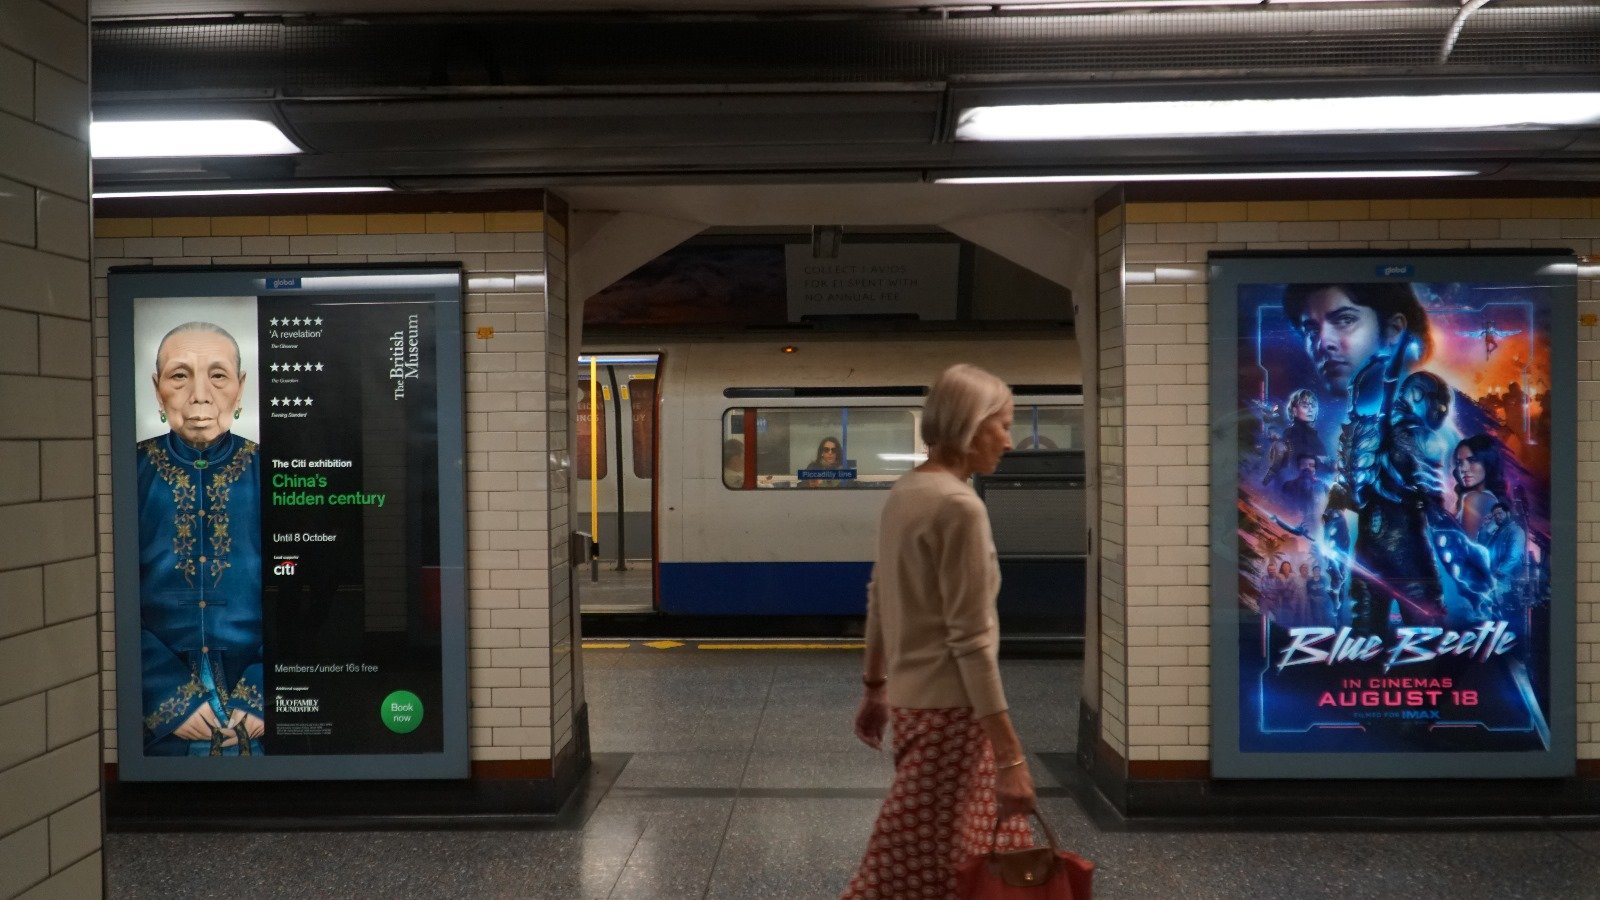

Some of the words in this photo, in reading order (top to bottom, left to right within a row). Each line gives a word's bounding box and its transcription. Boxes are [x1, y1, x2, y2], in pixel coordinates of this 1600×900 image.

[273, 278, 295, 288] global
[888, 279, 918, 288] WITH
[404, 314, 419, 380] Museum
[389, 330, 404, 380] British
[394, 380, 405, 401] The
[272, 459, 289, 468] The
[291, 459, 306, 468] Citi
[308, 459, 352, 468] exhibition
[802, 470, 836, 479] Piccadilly
[272, 491, 325, 506] hidden
[328, 491, 386, 508] century
[273, 533, 293, 543] Until
[294, 533, 301, 542] 8
[302, 533, 337, 542] October
[273, 563, 295, 576] citi
[1277, 625, 1383, 675] Blue
[1383, 620, 1517, 674] Beetle
[274, 663, 343, 673] Members/under
[345, 663, 360, 673] 16s
[361, 663, 379, 673] free
[1343, 678, 1361, 689] IN
[1369, 678, 1453, 689] CINEMAS
[1318, 690, 1443, 707] AUGUST
[1451, 690, 1479, 707] 18
[390, 702, 414, 712] Book
[393, 715, 412, 723] now
[1401, 710, 1441, 720] IMAX
